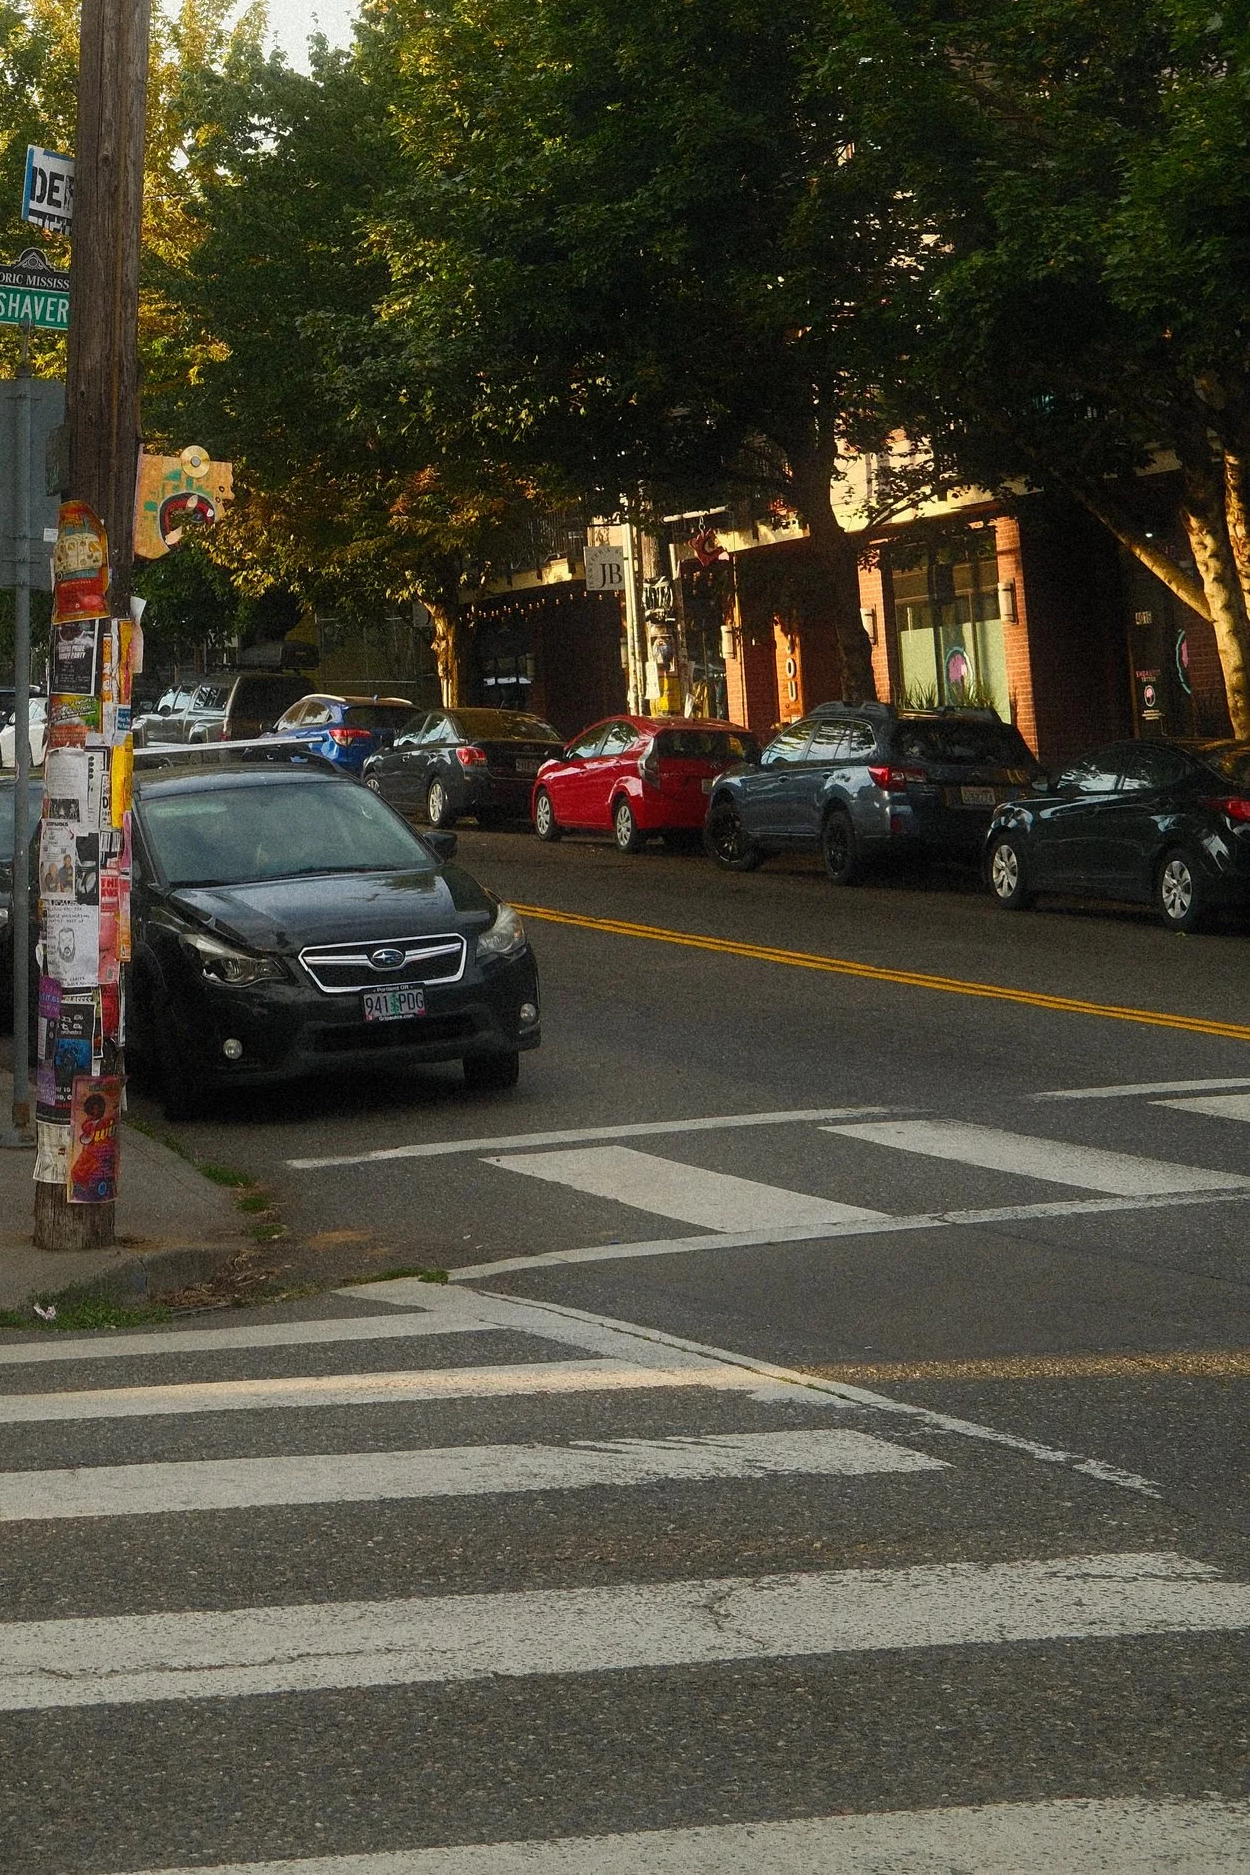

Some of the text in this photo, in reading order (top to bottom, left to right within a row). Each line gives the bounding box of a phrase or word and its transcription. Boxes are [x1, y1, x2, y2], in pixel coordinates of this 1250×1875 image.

[600, 563, 623, 590] JB
[365, 991, 425, 1015] 941 PDG
